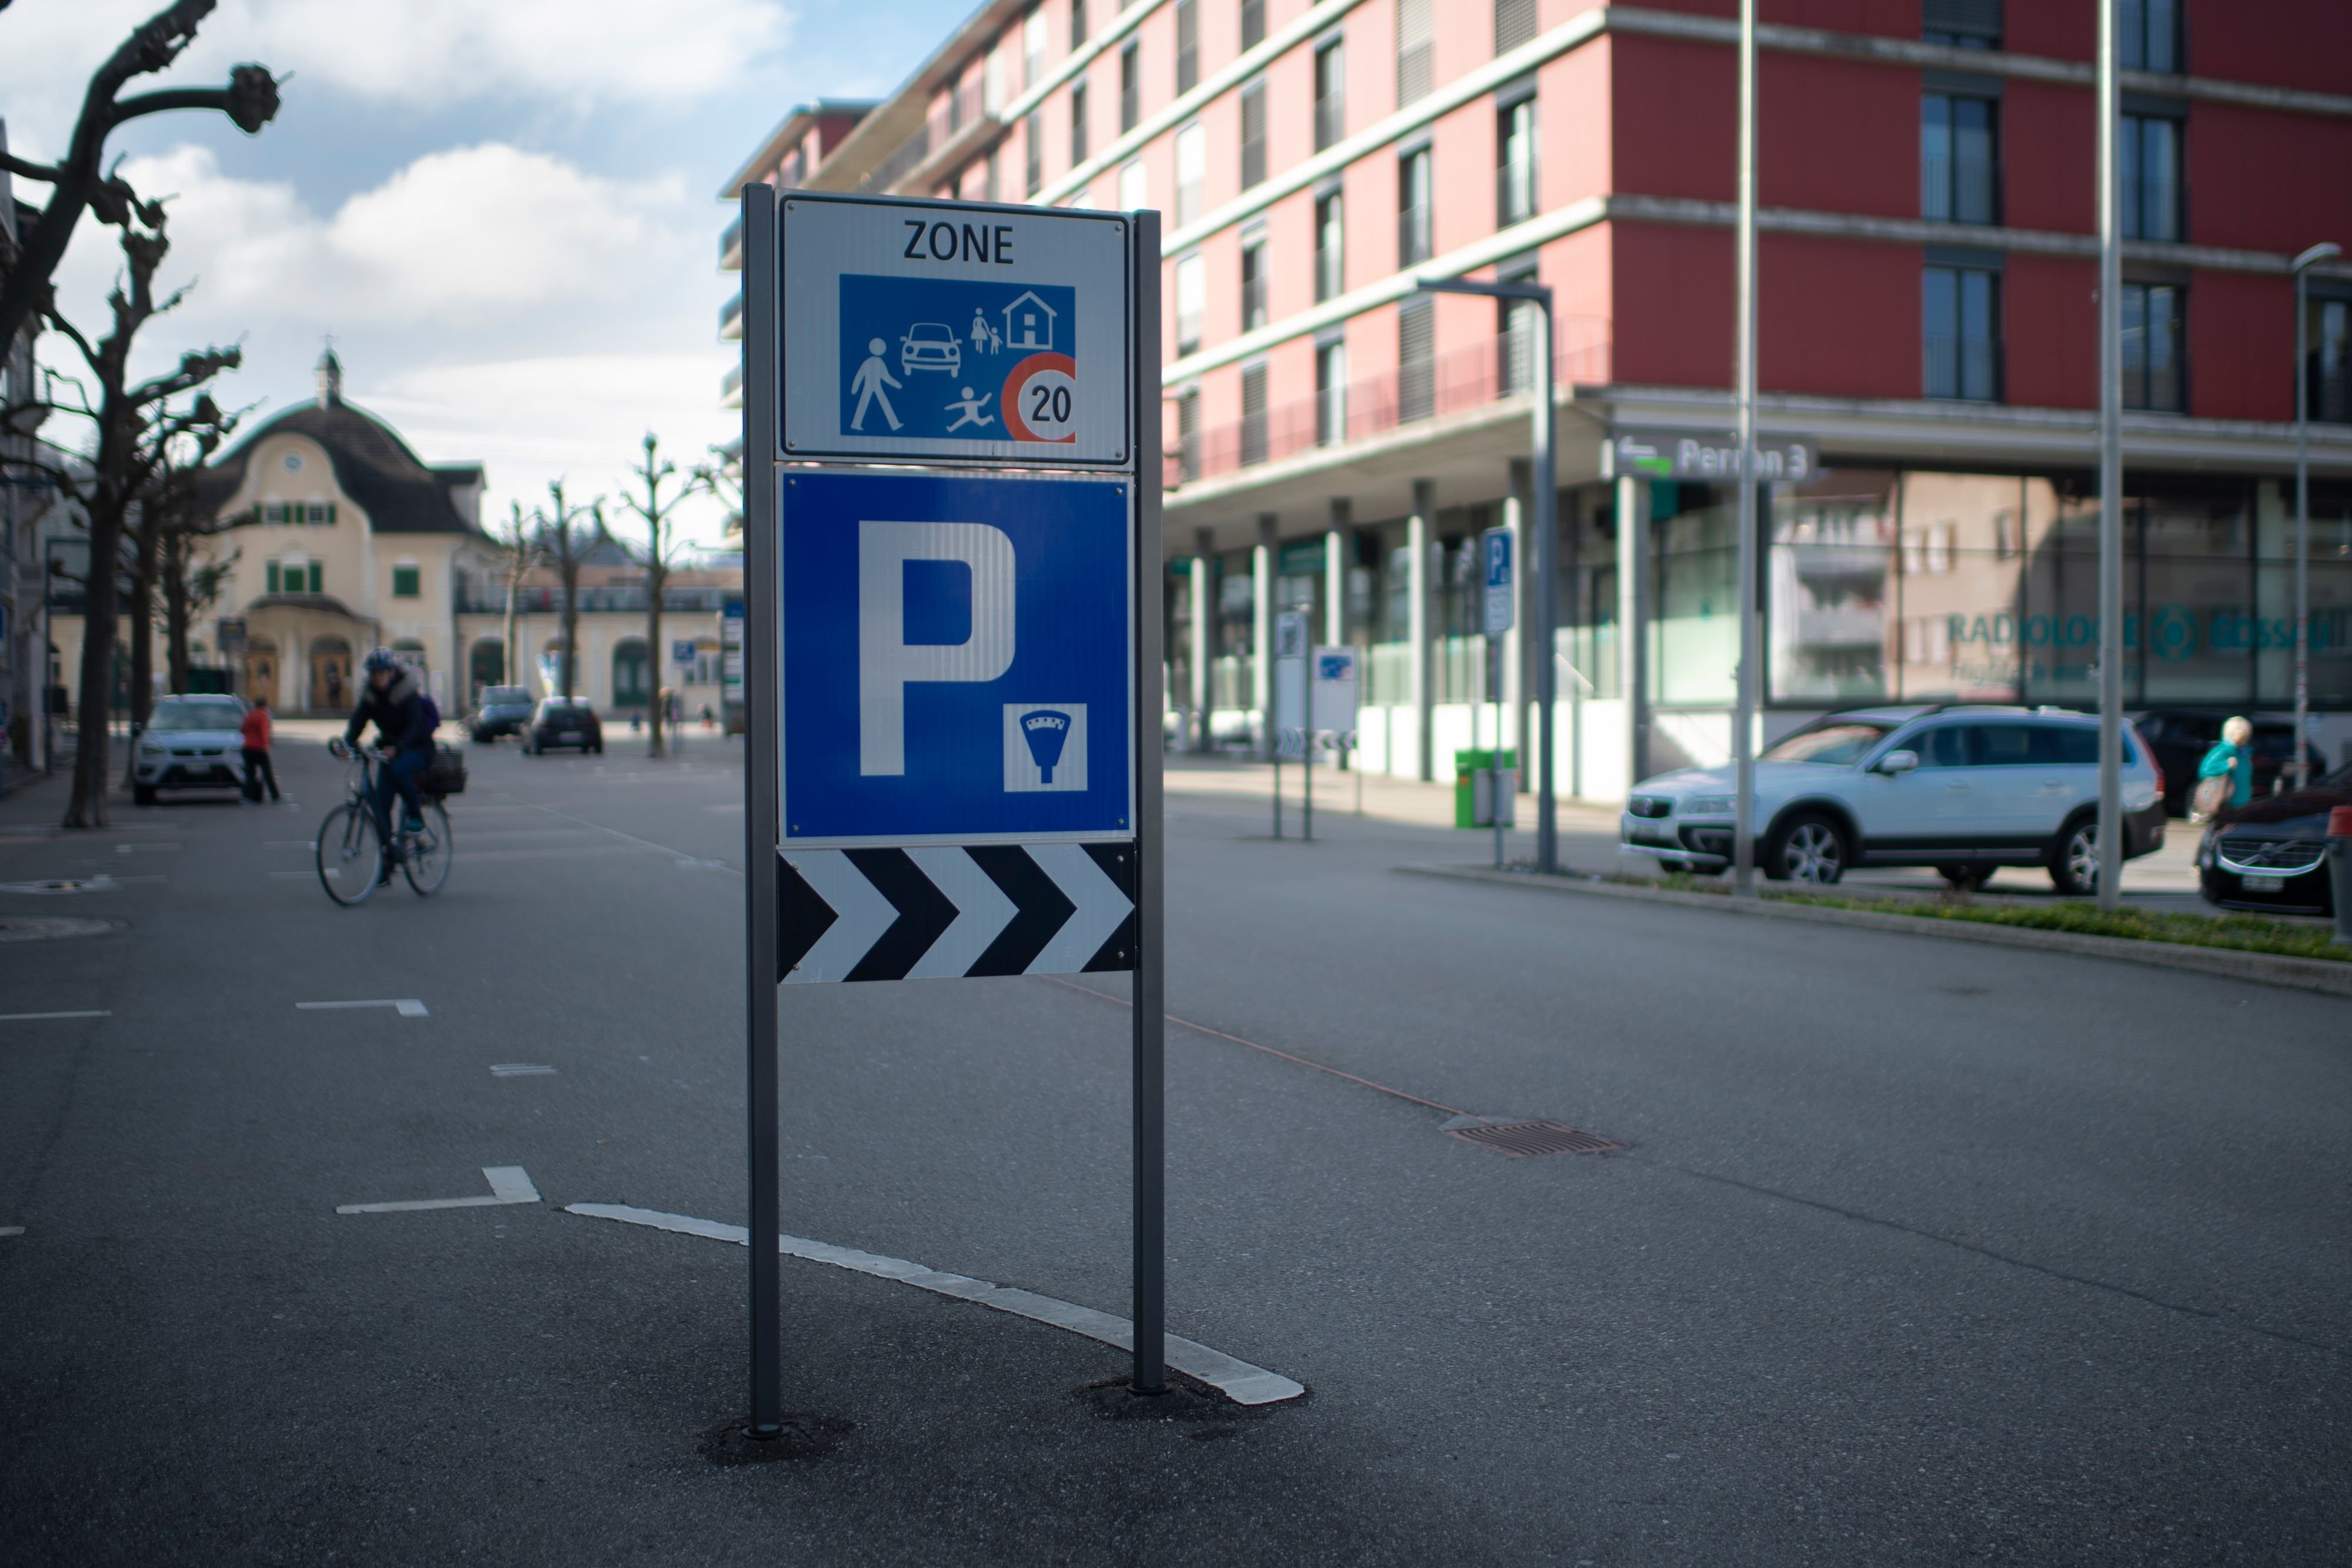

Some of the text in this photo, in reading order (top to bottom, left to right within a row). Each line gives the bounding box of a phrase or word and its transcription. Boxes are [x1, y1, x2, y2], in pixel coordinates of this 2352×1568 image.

[904, 219, 1014, 265] ZONE
[1031, 385, 1071, 423] 20
[1788, 444, 1808, 481] 3
[1491, 536, 1504, 581] P
[858, 520, 1016, 777] P
[1948, 613, 2141, 647] RADIOLOE
